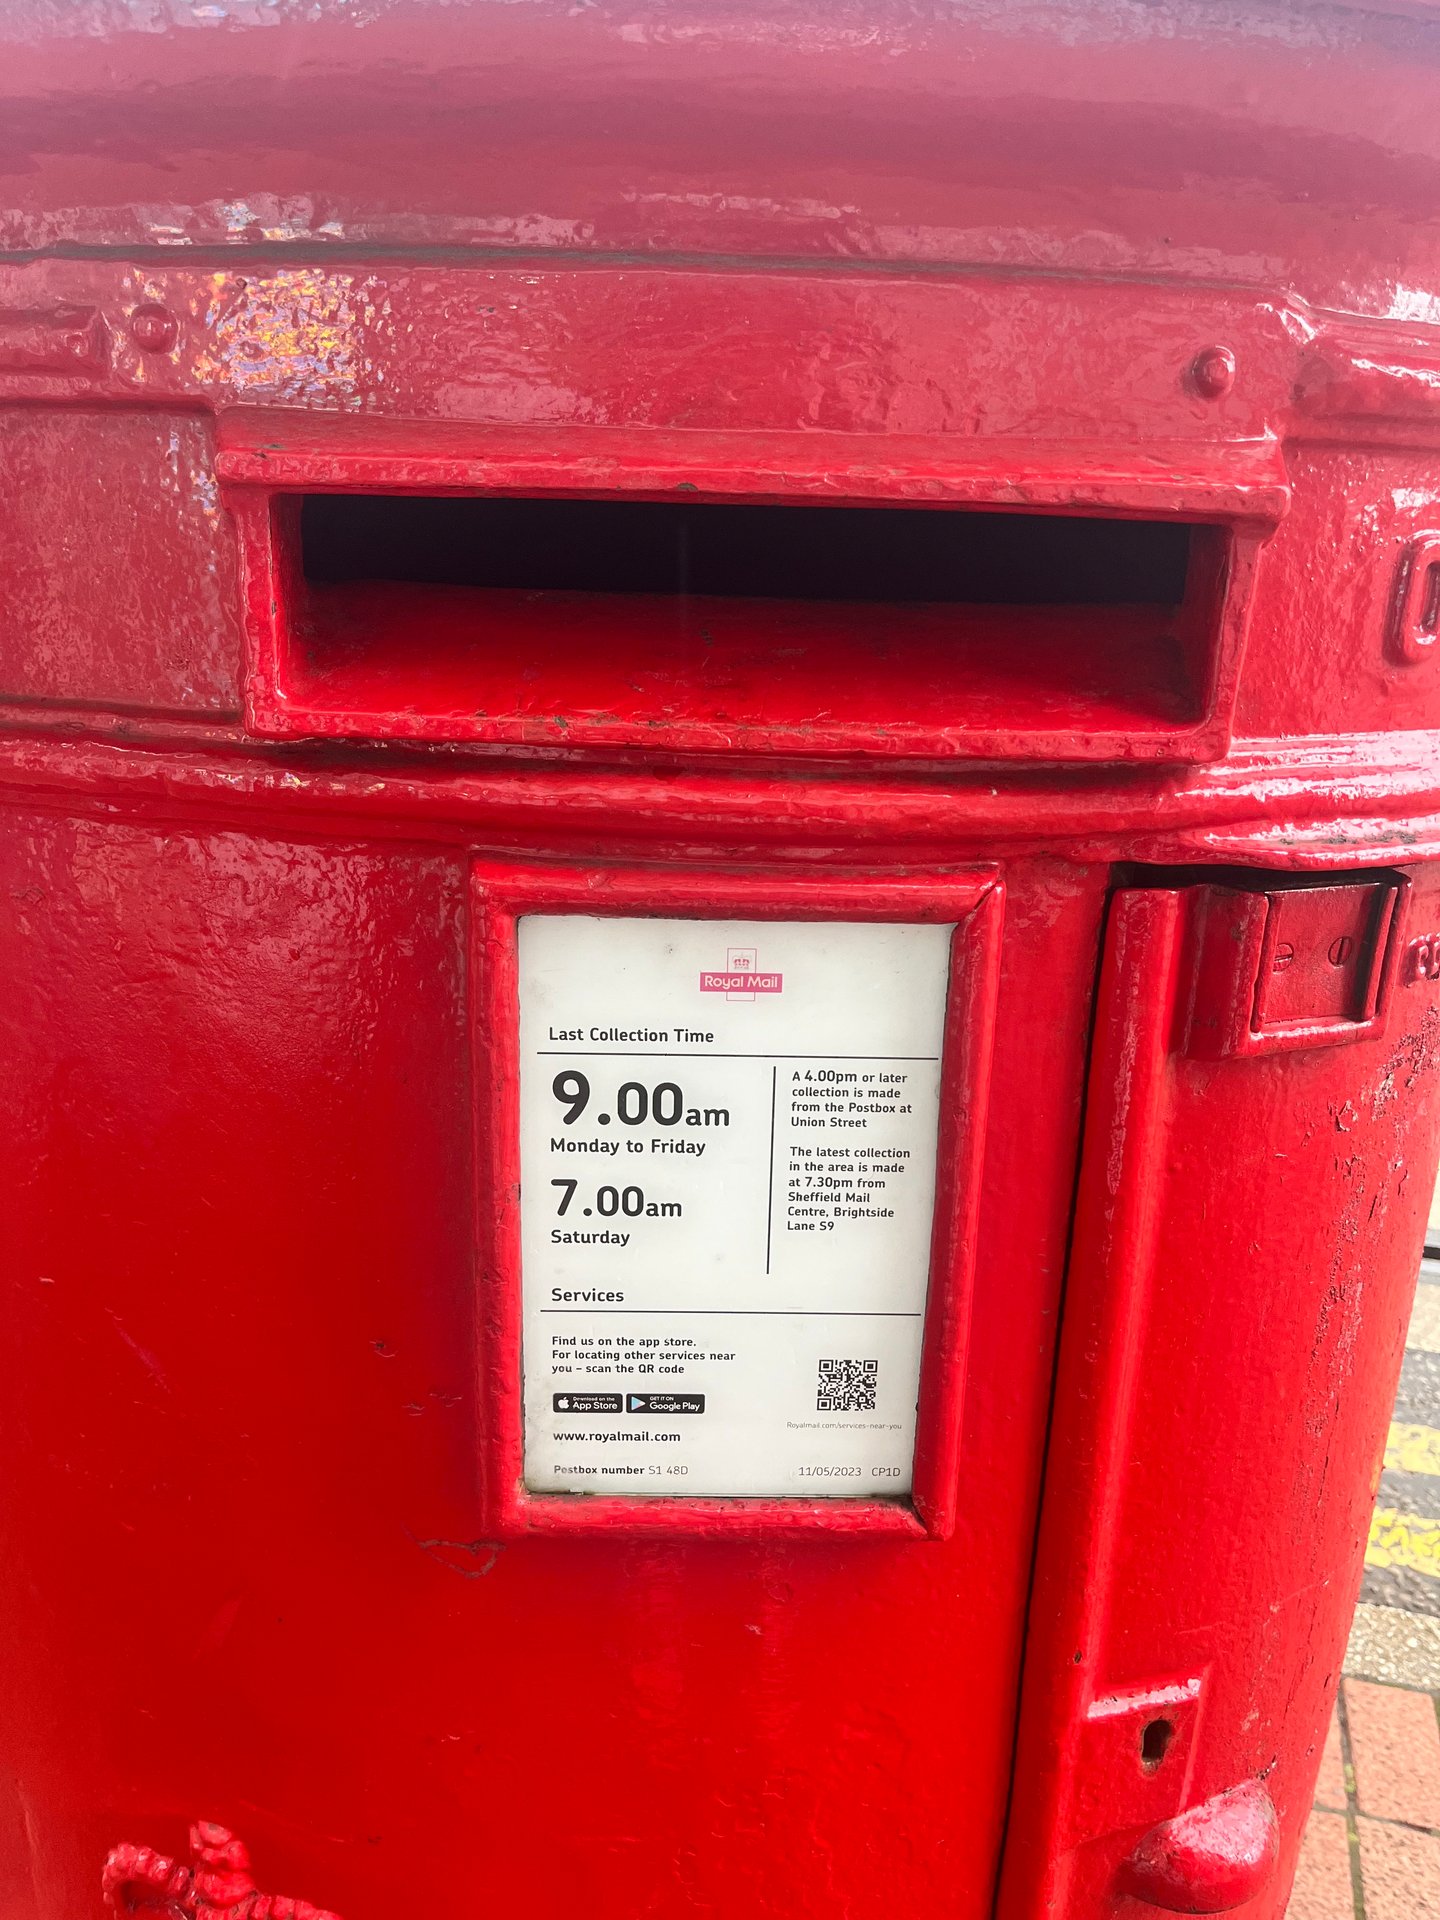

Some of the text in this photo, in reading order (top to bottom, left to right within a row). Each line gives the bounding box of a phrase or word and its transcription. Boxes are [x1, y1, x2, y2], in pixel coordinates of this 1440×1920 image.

[704, 974, 779, 990] Royal Mail
[549, 1026, 714, 1043] Last Collection Time
[792, 1069, 908, 1085] A 4.00pm or later
[552, 1069, 730, 1127] 9.00am
[792, 1086, 901, 1099] collection is made
[791, 1101, 912, 1114] from the Postbox at
[791, 1116, 868, 1128] Union Street
[550, 1137, 706, 1158] Monday to Friday
[789, 1146, 911, 1159] The latest collection
[789, 1160, 905, 1173] in the area is made
[788, 1176, 886, 1190] at 7.30pm from
[550, 1178, 682, 1218] 7.00am
[787, 1191, 871, 1203] Sheffield Mail
[787, 1206, 895, 1219] Centre, Brightside
[787, 1220, 835, 1231] Lane S9
[550, 1229, 631, 1248] Saturday
[551, 1287, 625, 1303] Services
[552, 1335, 697, 1348] Find us on the app store.
[552, 1349, 736, 1362] For locating other services near
[551, 1365, 573, 1375] you
[585, 1365, 612, 1373] scan
[614, 1363, 635, 1374] the
[638, 1363, 655, 1374] QR
[658, 1364, 685, 1374] code
[572, 1401, 618, 1411] App Store
[649, 1401, 701, 1412] Google Play
[786, 1421, 903, 1431] Royalmail.com/services-near-you
[553, 1430, 681, 1444] www.royalmail.com
[554, 1465, 689, 1476] Postbox number S1 48D
[798, 1466, 901, 1477] 11/05/2023 CP1D
